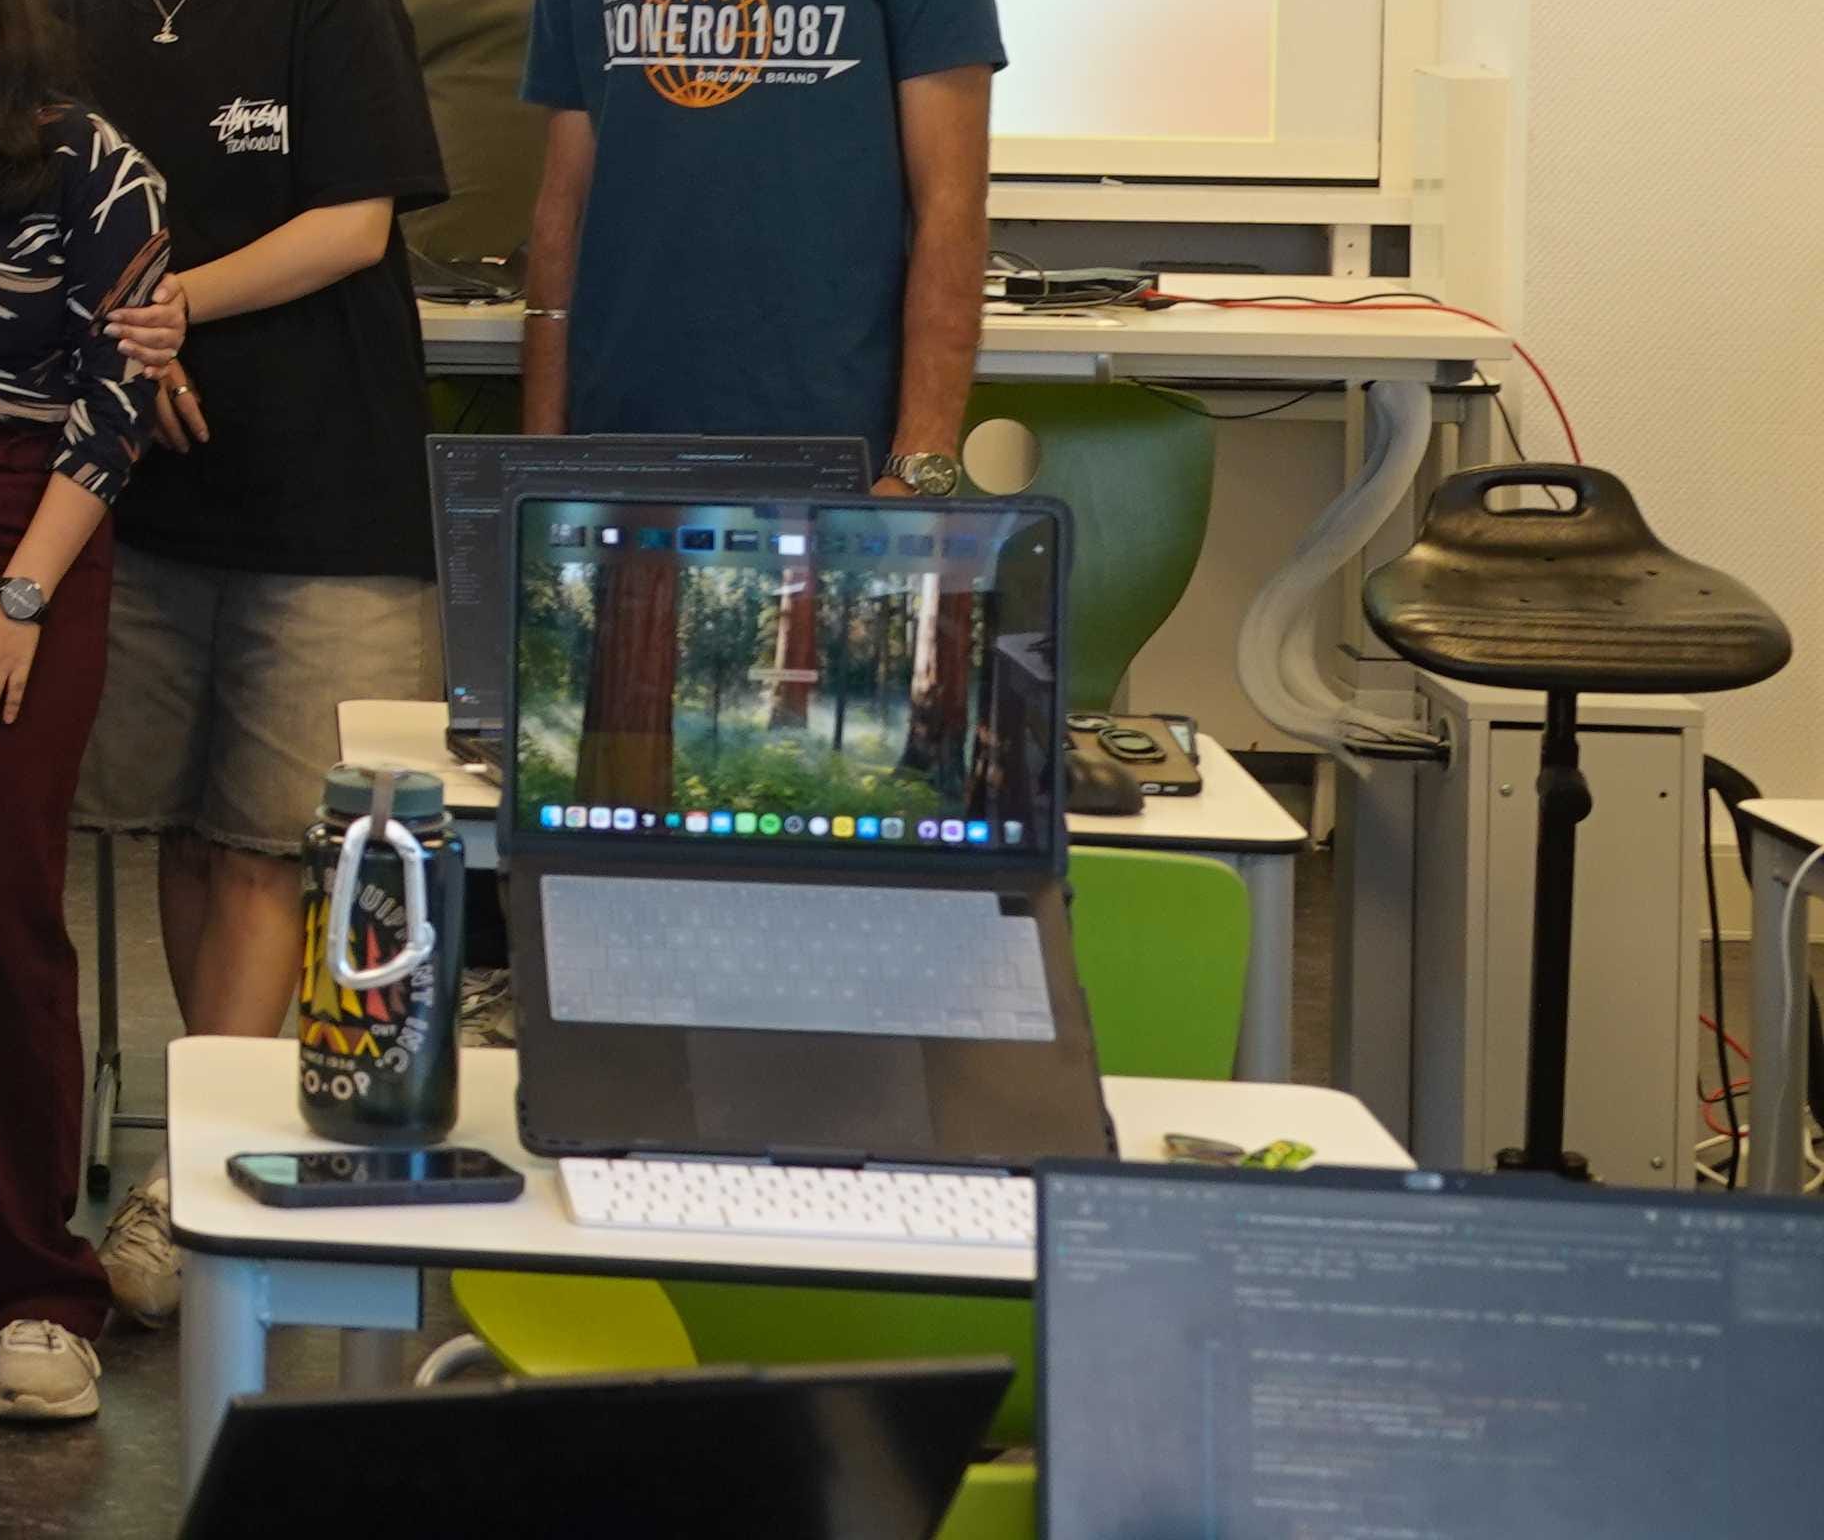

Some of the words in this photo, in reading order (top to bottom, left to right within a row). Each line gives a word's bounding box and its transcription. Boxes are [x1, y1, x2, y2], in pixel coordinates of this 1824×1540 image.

[751, 5, 846, 55] 1987
[695, 70, 762, 84] ORIGINAL
[765, 71, 818, 84] BRAND
